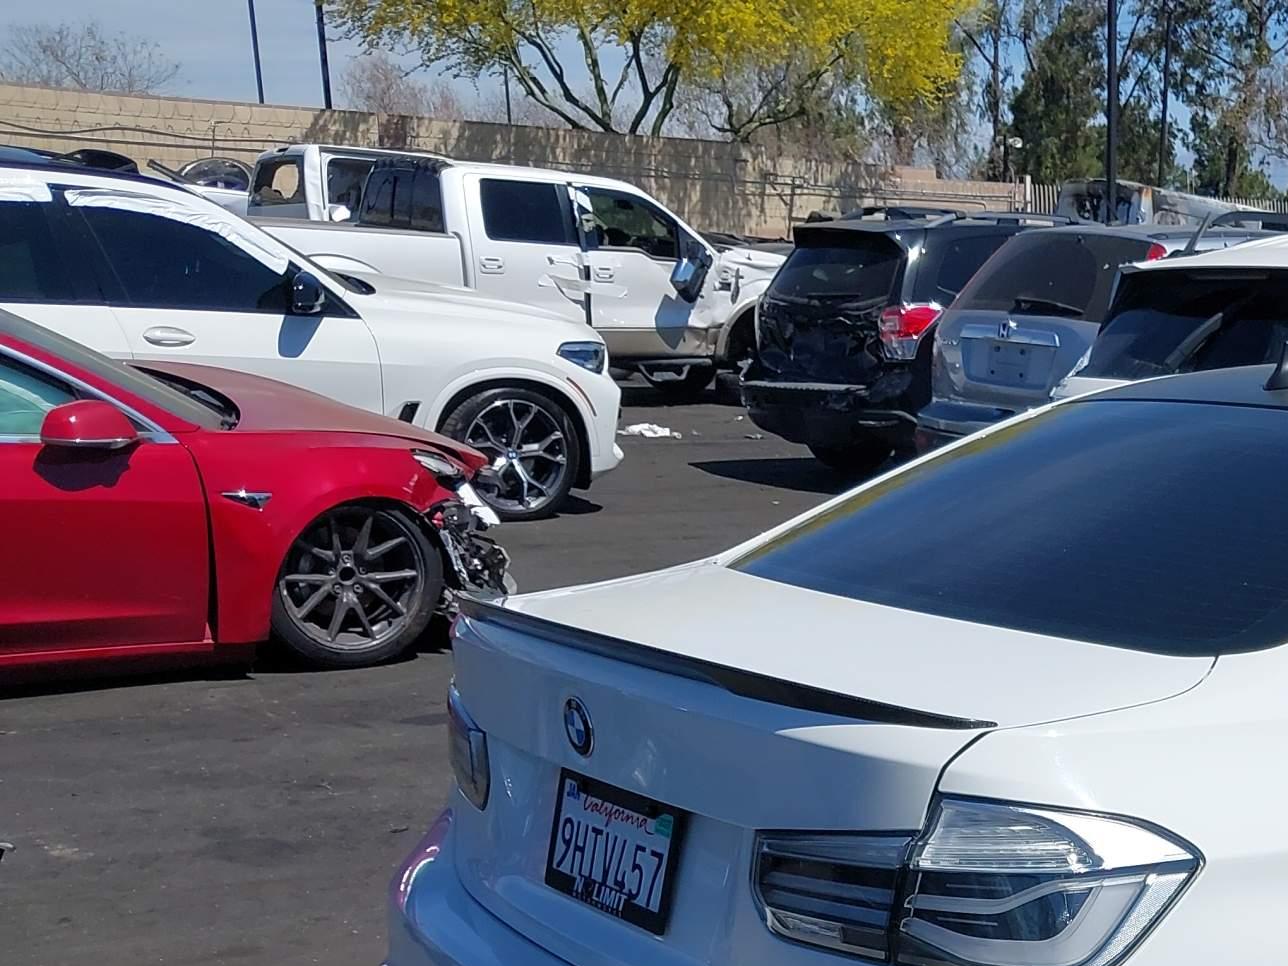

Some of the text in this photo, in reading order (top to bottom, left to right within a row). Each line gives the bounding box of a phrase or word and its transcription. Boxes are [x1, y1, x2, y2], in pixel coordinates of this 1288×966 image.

[583, 794, 654, 836] California
[556, 816, 664, 908] 9HTV457
[592, 883, 628, 912] LIMIT
